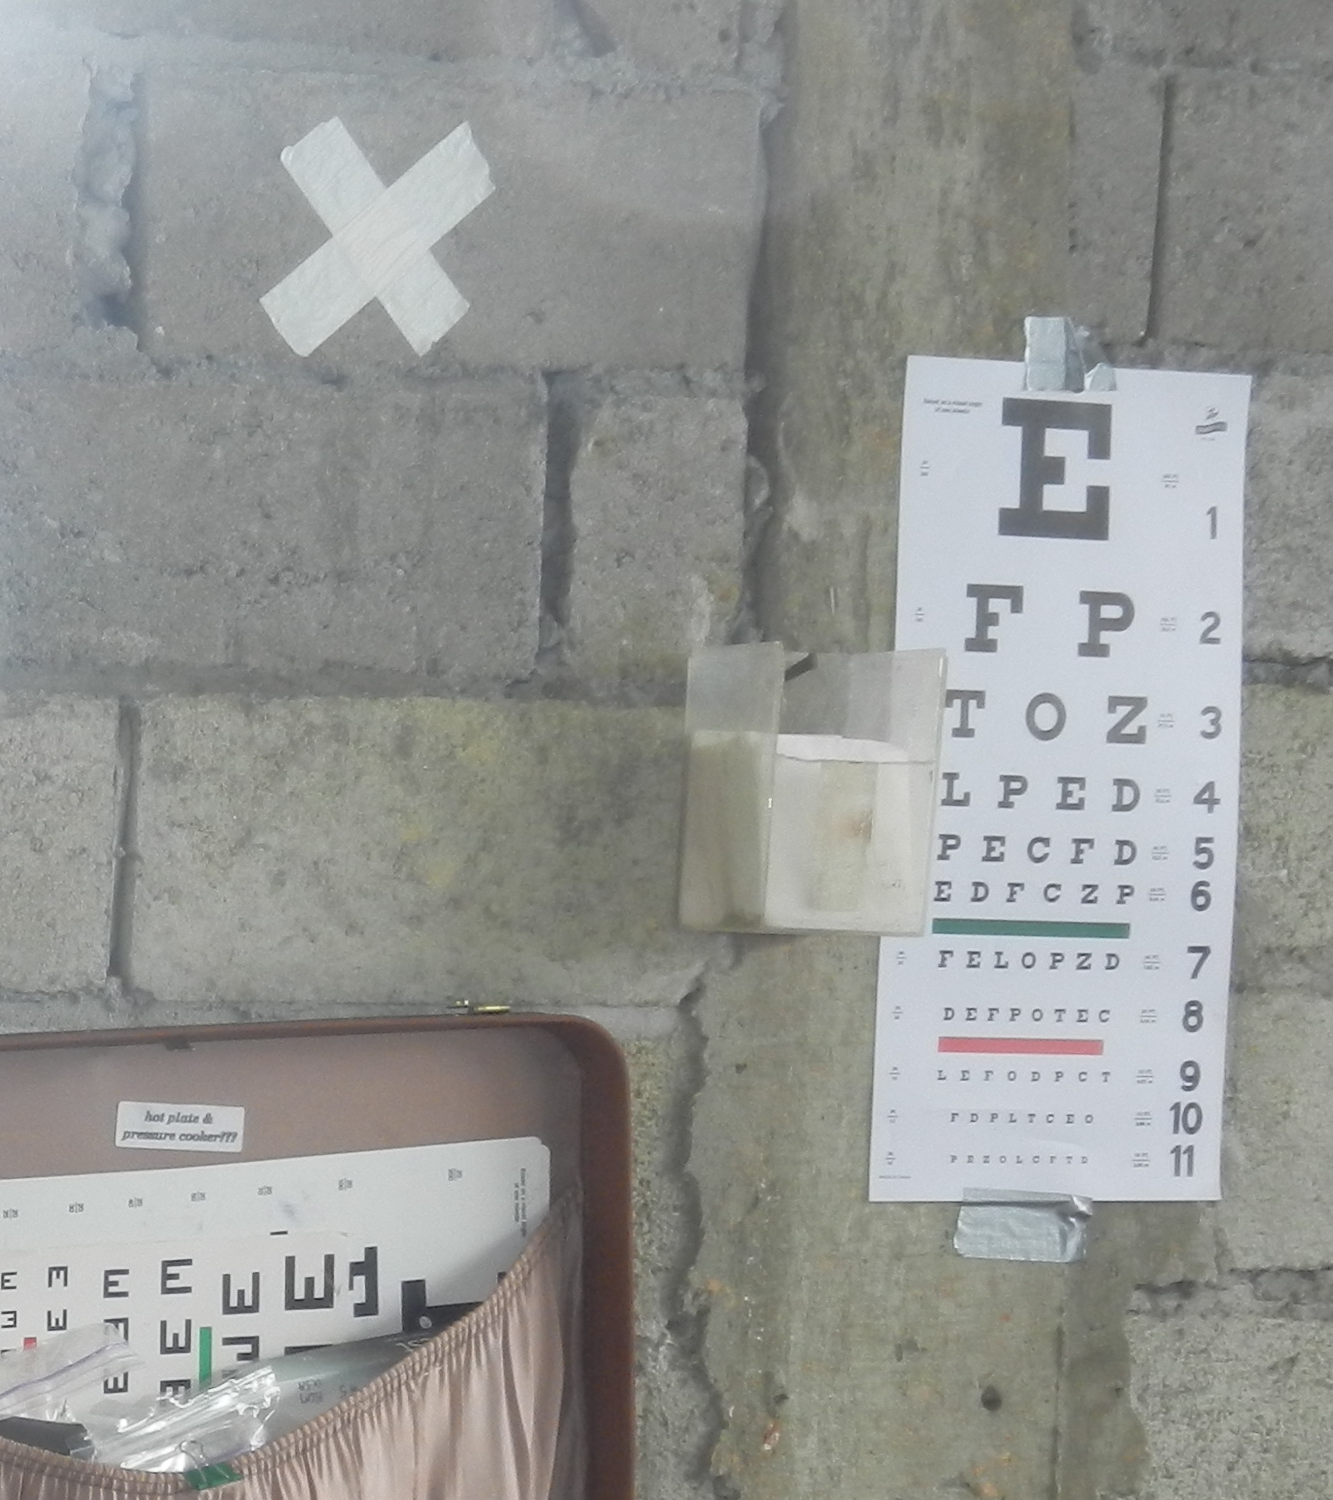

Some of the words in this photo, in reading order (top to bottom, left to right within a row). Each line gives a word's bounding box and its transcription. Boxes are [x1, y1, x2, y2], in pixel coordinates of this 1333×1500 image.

[999, 398, 1111, 540] E
[1206, 506, 1217, 539] 1
[1199, 611, 1221, 645] 2
[1200, 705, 1222, 740] 3
[1193, 781, 1221, 813] 4
[1192, 837, 1215, 870] 5
[1190, 881, 1212, 911] 6
[1186, 946, 1212, 979] 7
[1181, 1000, 1204, 1033] 8
[1179, 1060, 1202, 1092] 9
[144, 1111, 165, 1122] hot
[166, 1112, 199, 1125] plate
[202, 1112, 213, 1124] &
[1169, 1101, 1203, 1135] 10
[121, 1131, 176, 1141] pressure
[1169, 1144, 1195, 1177] 11
